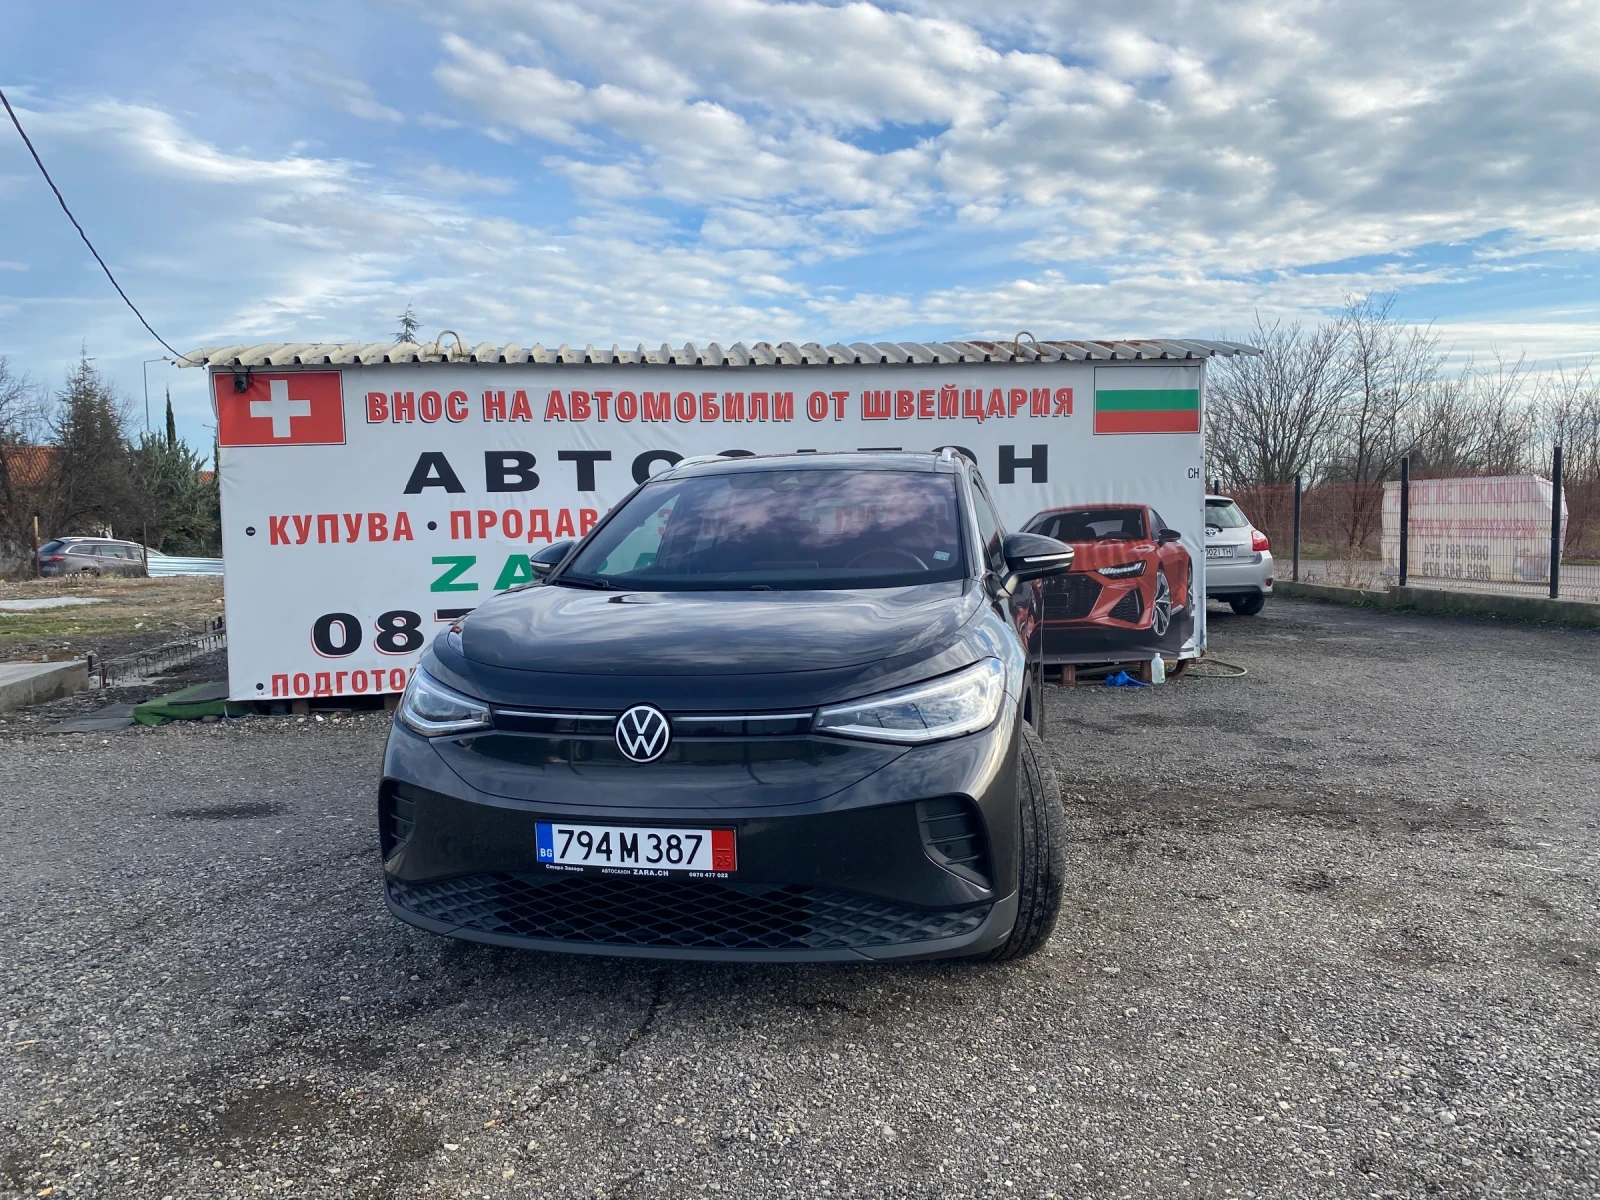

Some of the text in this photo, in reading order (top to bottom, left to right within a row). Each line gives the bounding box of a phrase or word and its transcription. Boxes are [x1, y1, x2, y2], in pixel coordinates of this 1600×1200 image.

[366, 384, 1074, 424] ВНОС НА АВТОМОБИЛИ ОТ ШВЕЙЦАРИЯ
[269, 507, 612, 545] КУПУВА ПРОДАВ
[310, 607, 477, 659] 08
[271, 668, 414, 698] ПОДГОТО
[540, 847, 553, 858] BG
[633, 869, 669, 877] ZARA.CH
